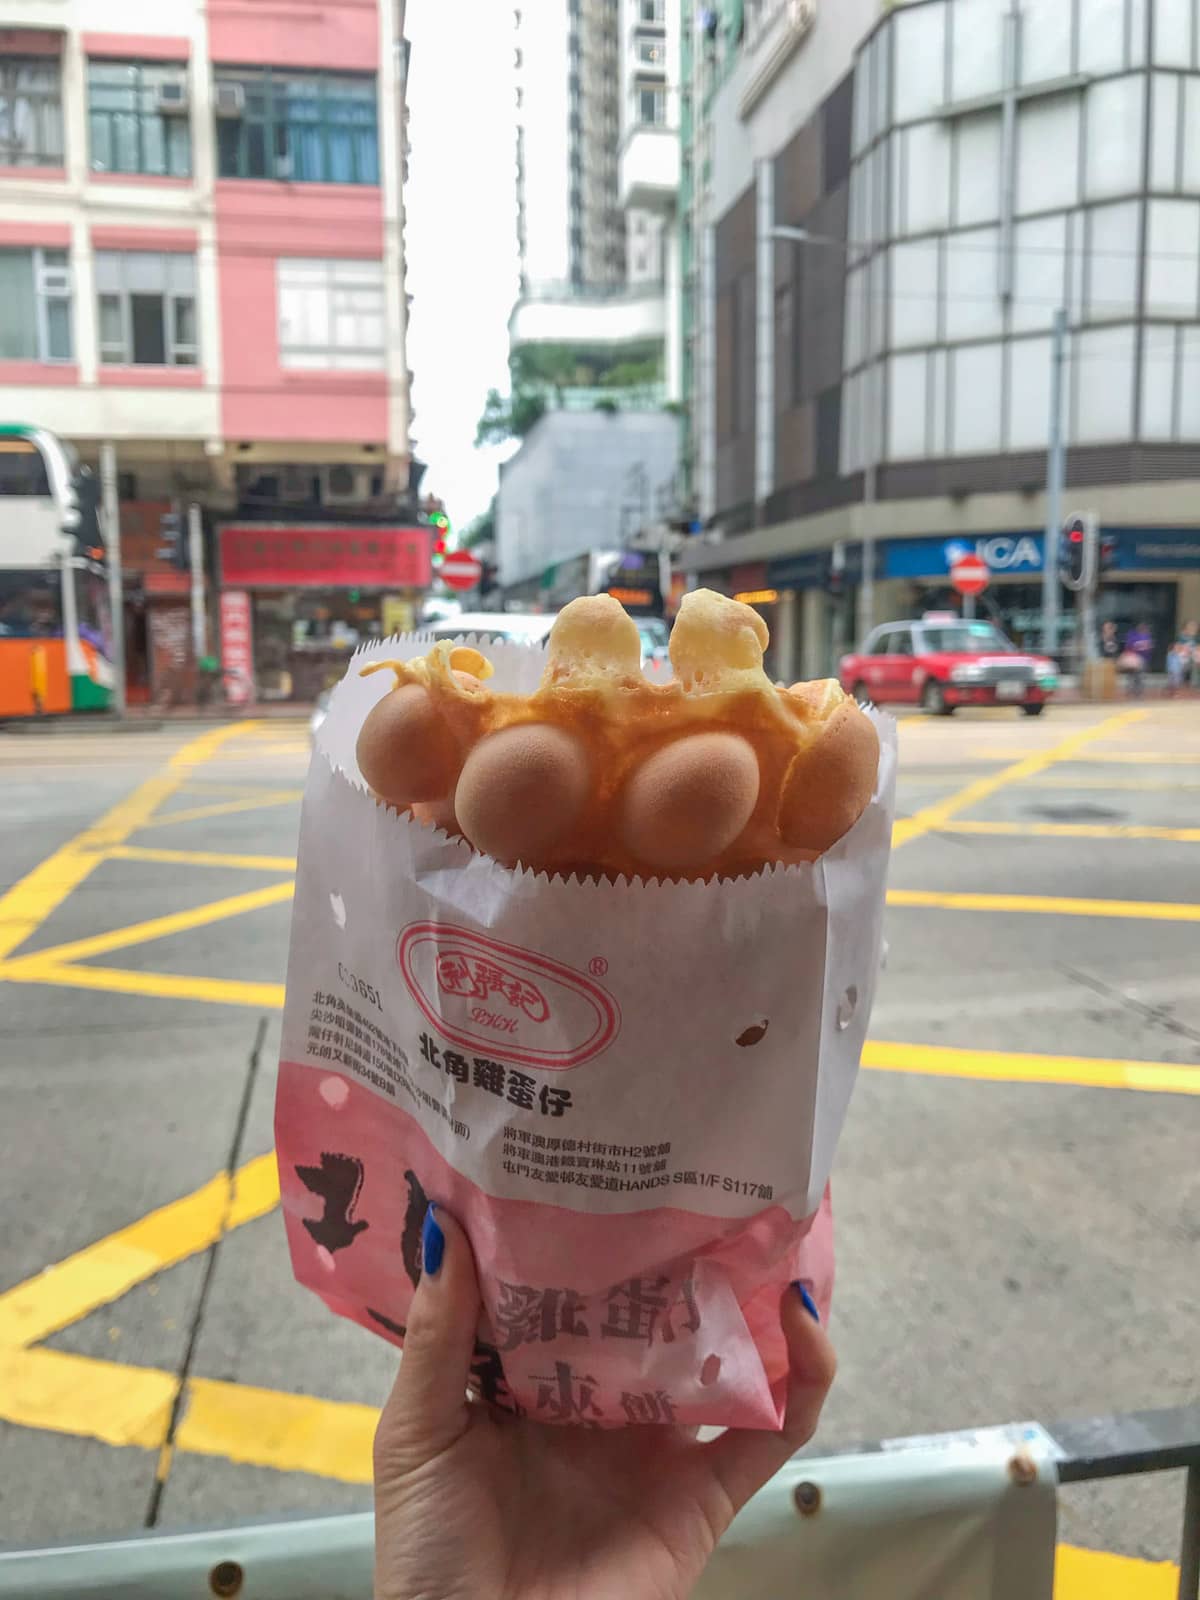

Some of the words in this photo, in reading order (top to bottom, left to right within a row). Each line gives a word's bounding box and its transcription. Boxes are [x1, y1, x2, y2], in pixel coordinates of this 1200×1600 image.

[418, 1031, 573, 1118] 北角雞蛋仔
